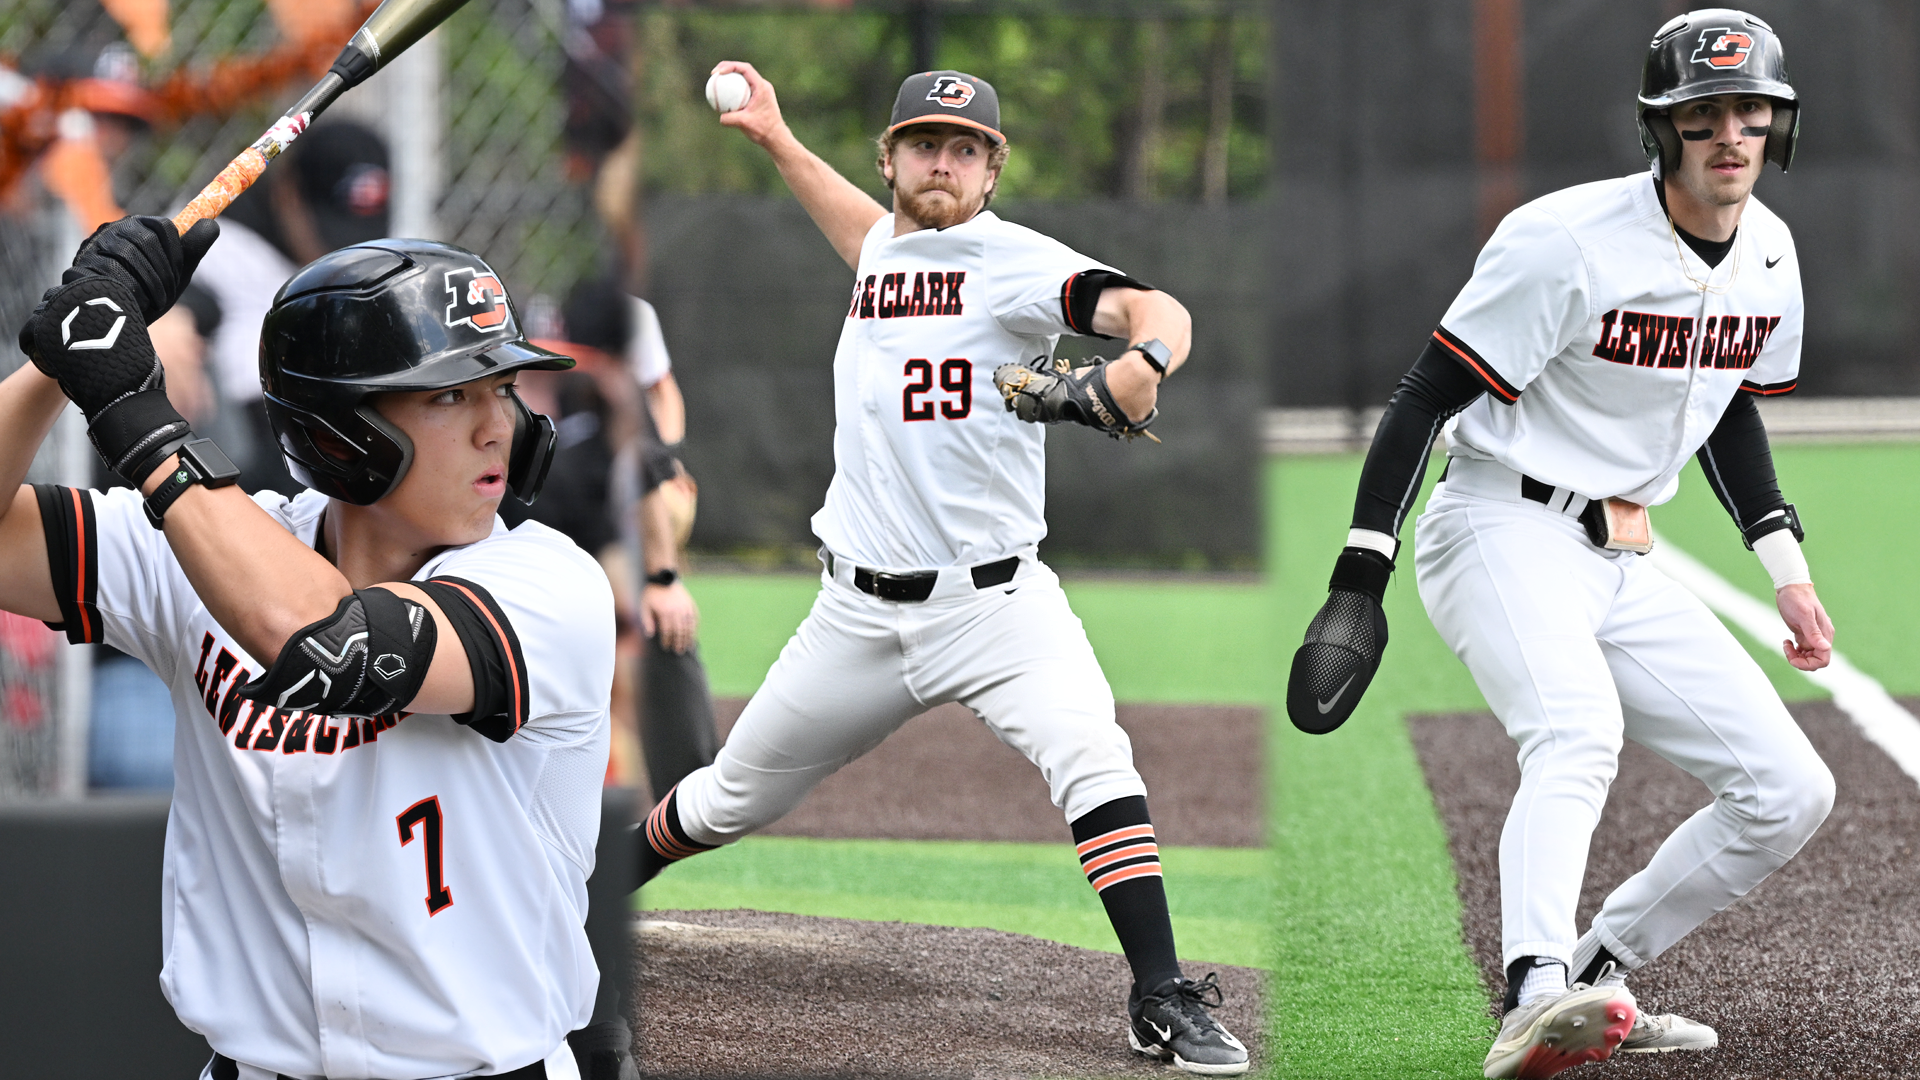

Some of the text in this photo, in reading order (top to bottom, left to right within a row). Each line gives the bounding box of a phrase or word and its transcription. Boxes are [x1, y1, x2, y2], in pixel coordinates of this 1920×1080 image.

[1592, 309, 1695, 369] LEWIS
[903, 358, 973, 422] 29
[395, 794, 454, 918] 7
